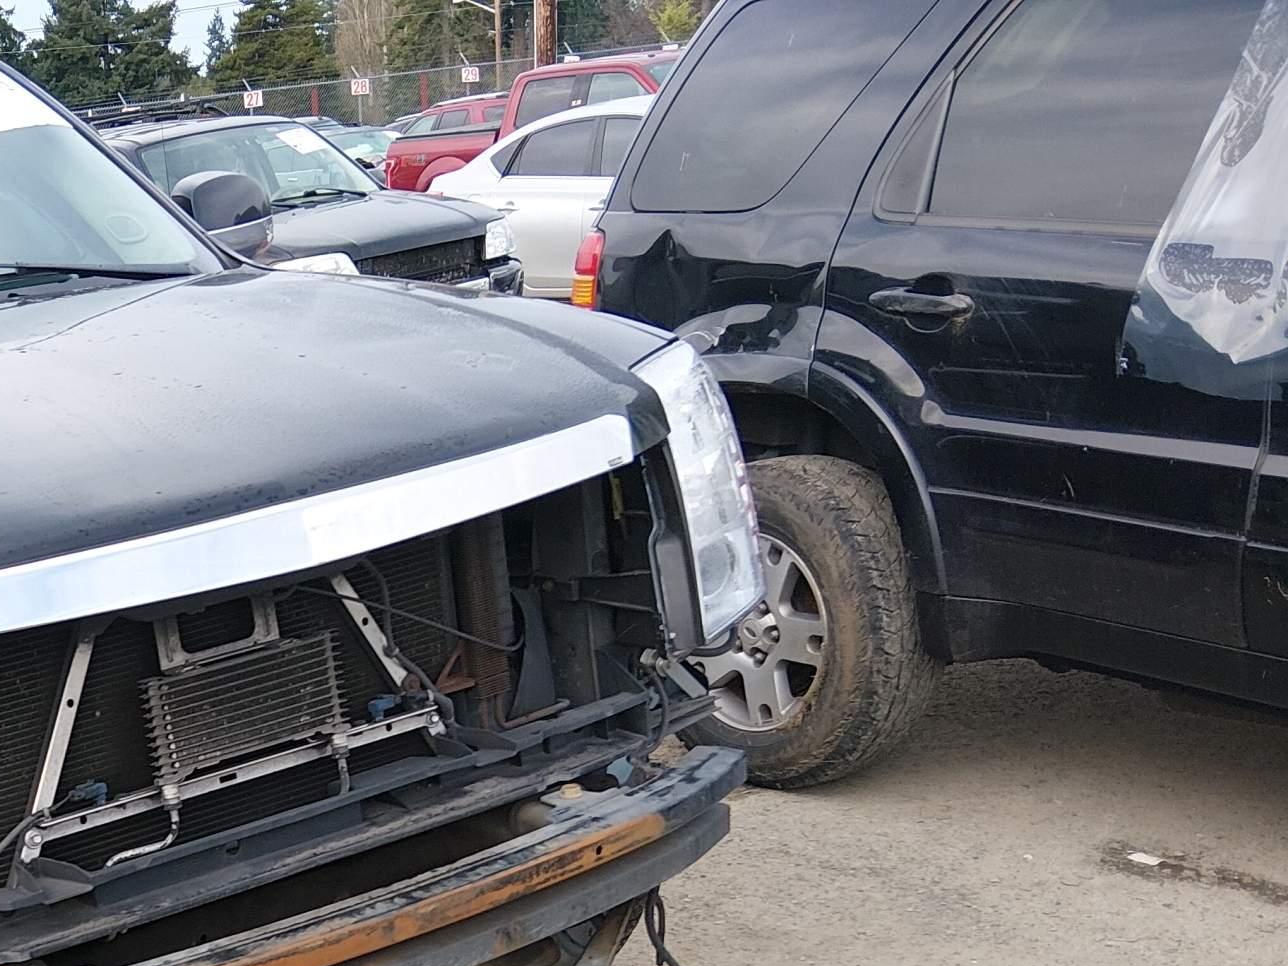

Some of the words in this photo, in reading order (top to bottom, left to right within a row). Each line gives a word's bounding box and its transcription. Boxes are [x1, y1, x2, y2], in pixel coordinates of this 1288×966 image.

[464, 67, 479, 81] 29
[353, 81, 368, 95] 28
[247, 92, 260, 107] 27
